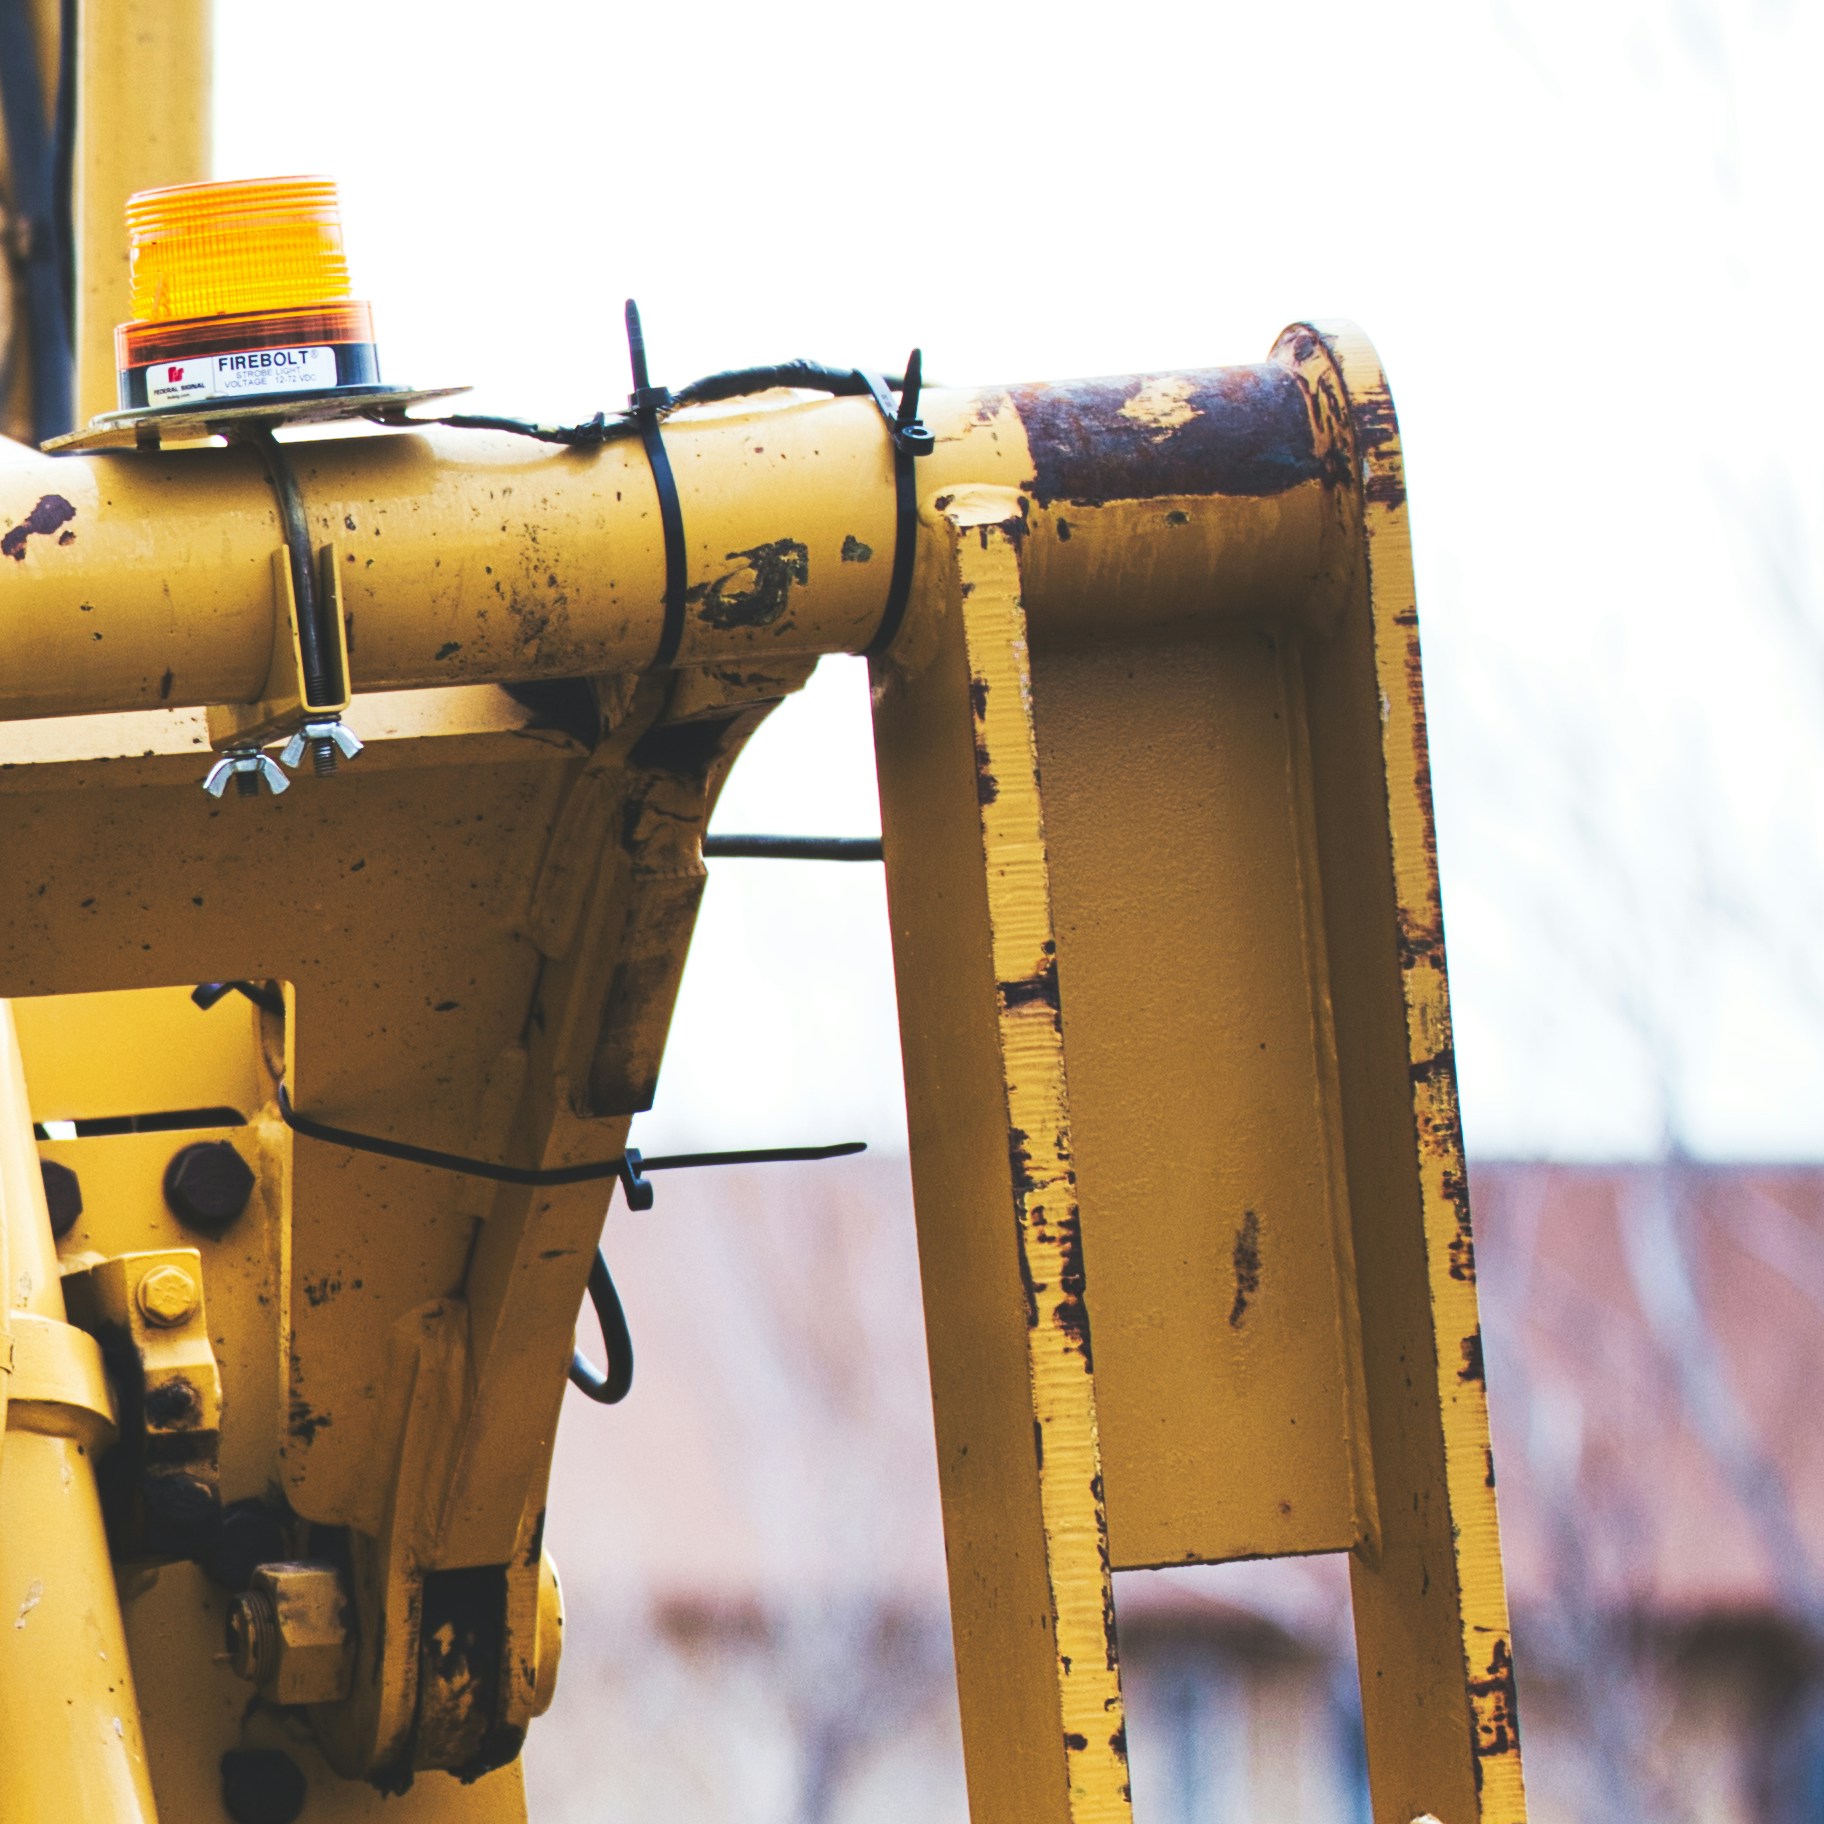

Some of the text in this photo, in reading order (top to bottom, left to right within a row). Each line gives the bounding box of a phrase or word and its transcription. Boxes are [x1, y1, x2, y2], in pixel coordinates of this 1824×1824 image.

[236, 366, 301, 379] STROBE LIGHT
[224, 374, 317, 388] VOLTAGE 12-72 VDC
